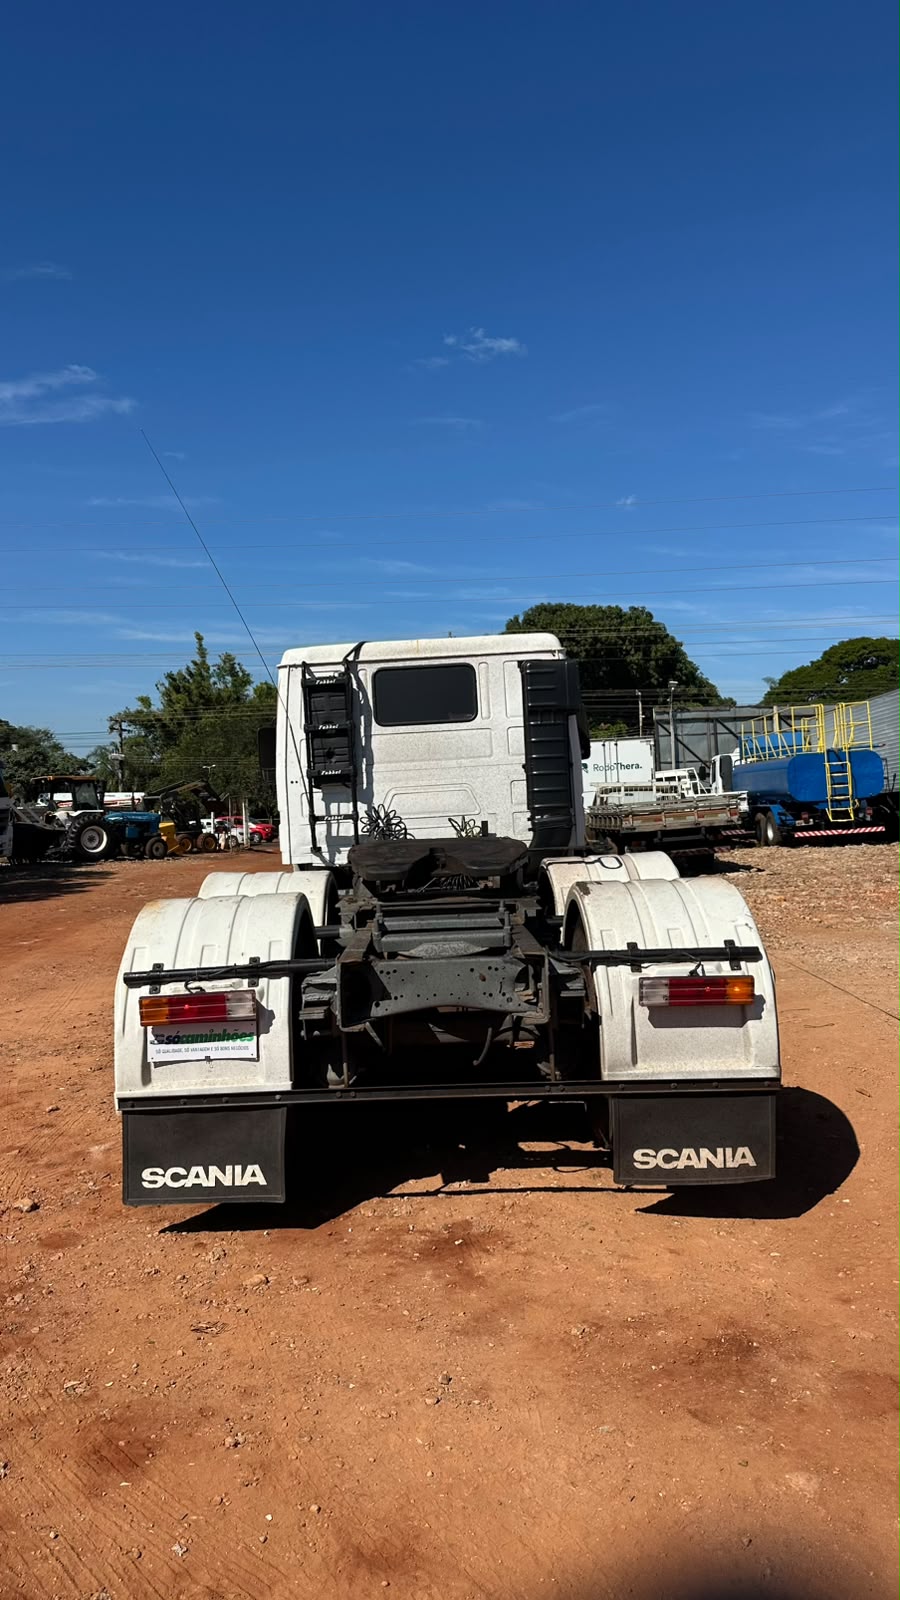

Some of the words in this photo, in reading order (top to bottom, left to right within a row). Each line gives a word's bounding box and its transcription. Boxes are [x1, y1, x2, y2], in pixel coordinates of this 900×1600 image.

[593, 762, 643, 772] RodoThera.
[632, 1146, 757, 1170] SCANIA
[141, 1164, 267, 1189] SCANIA
